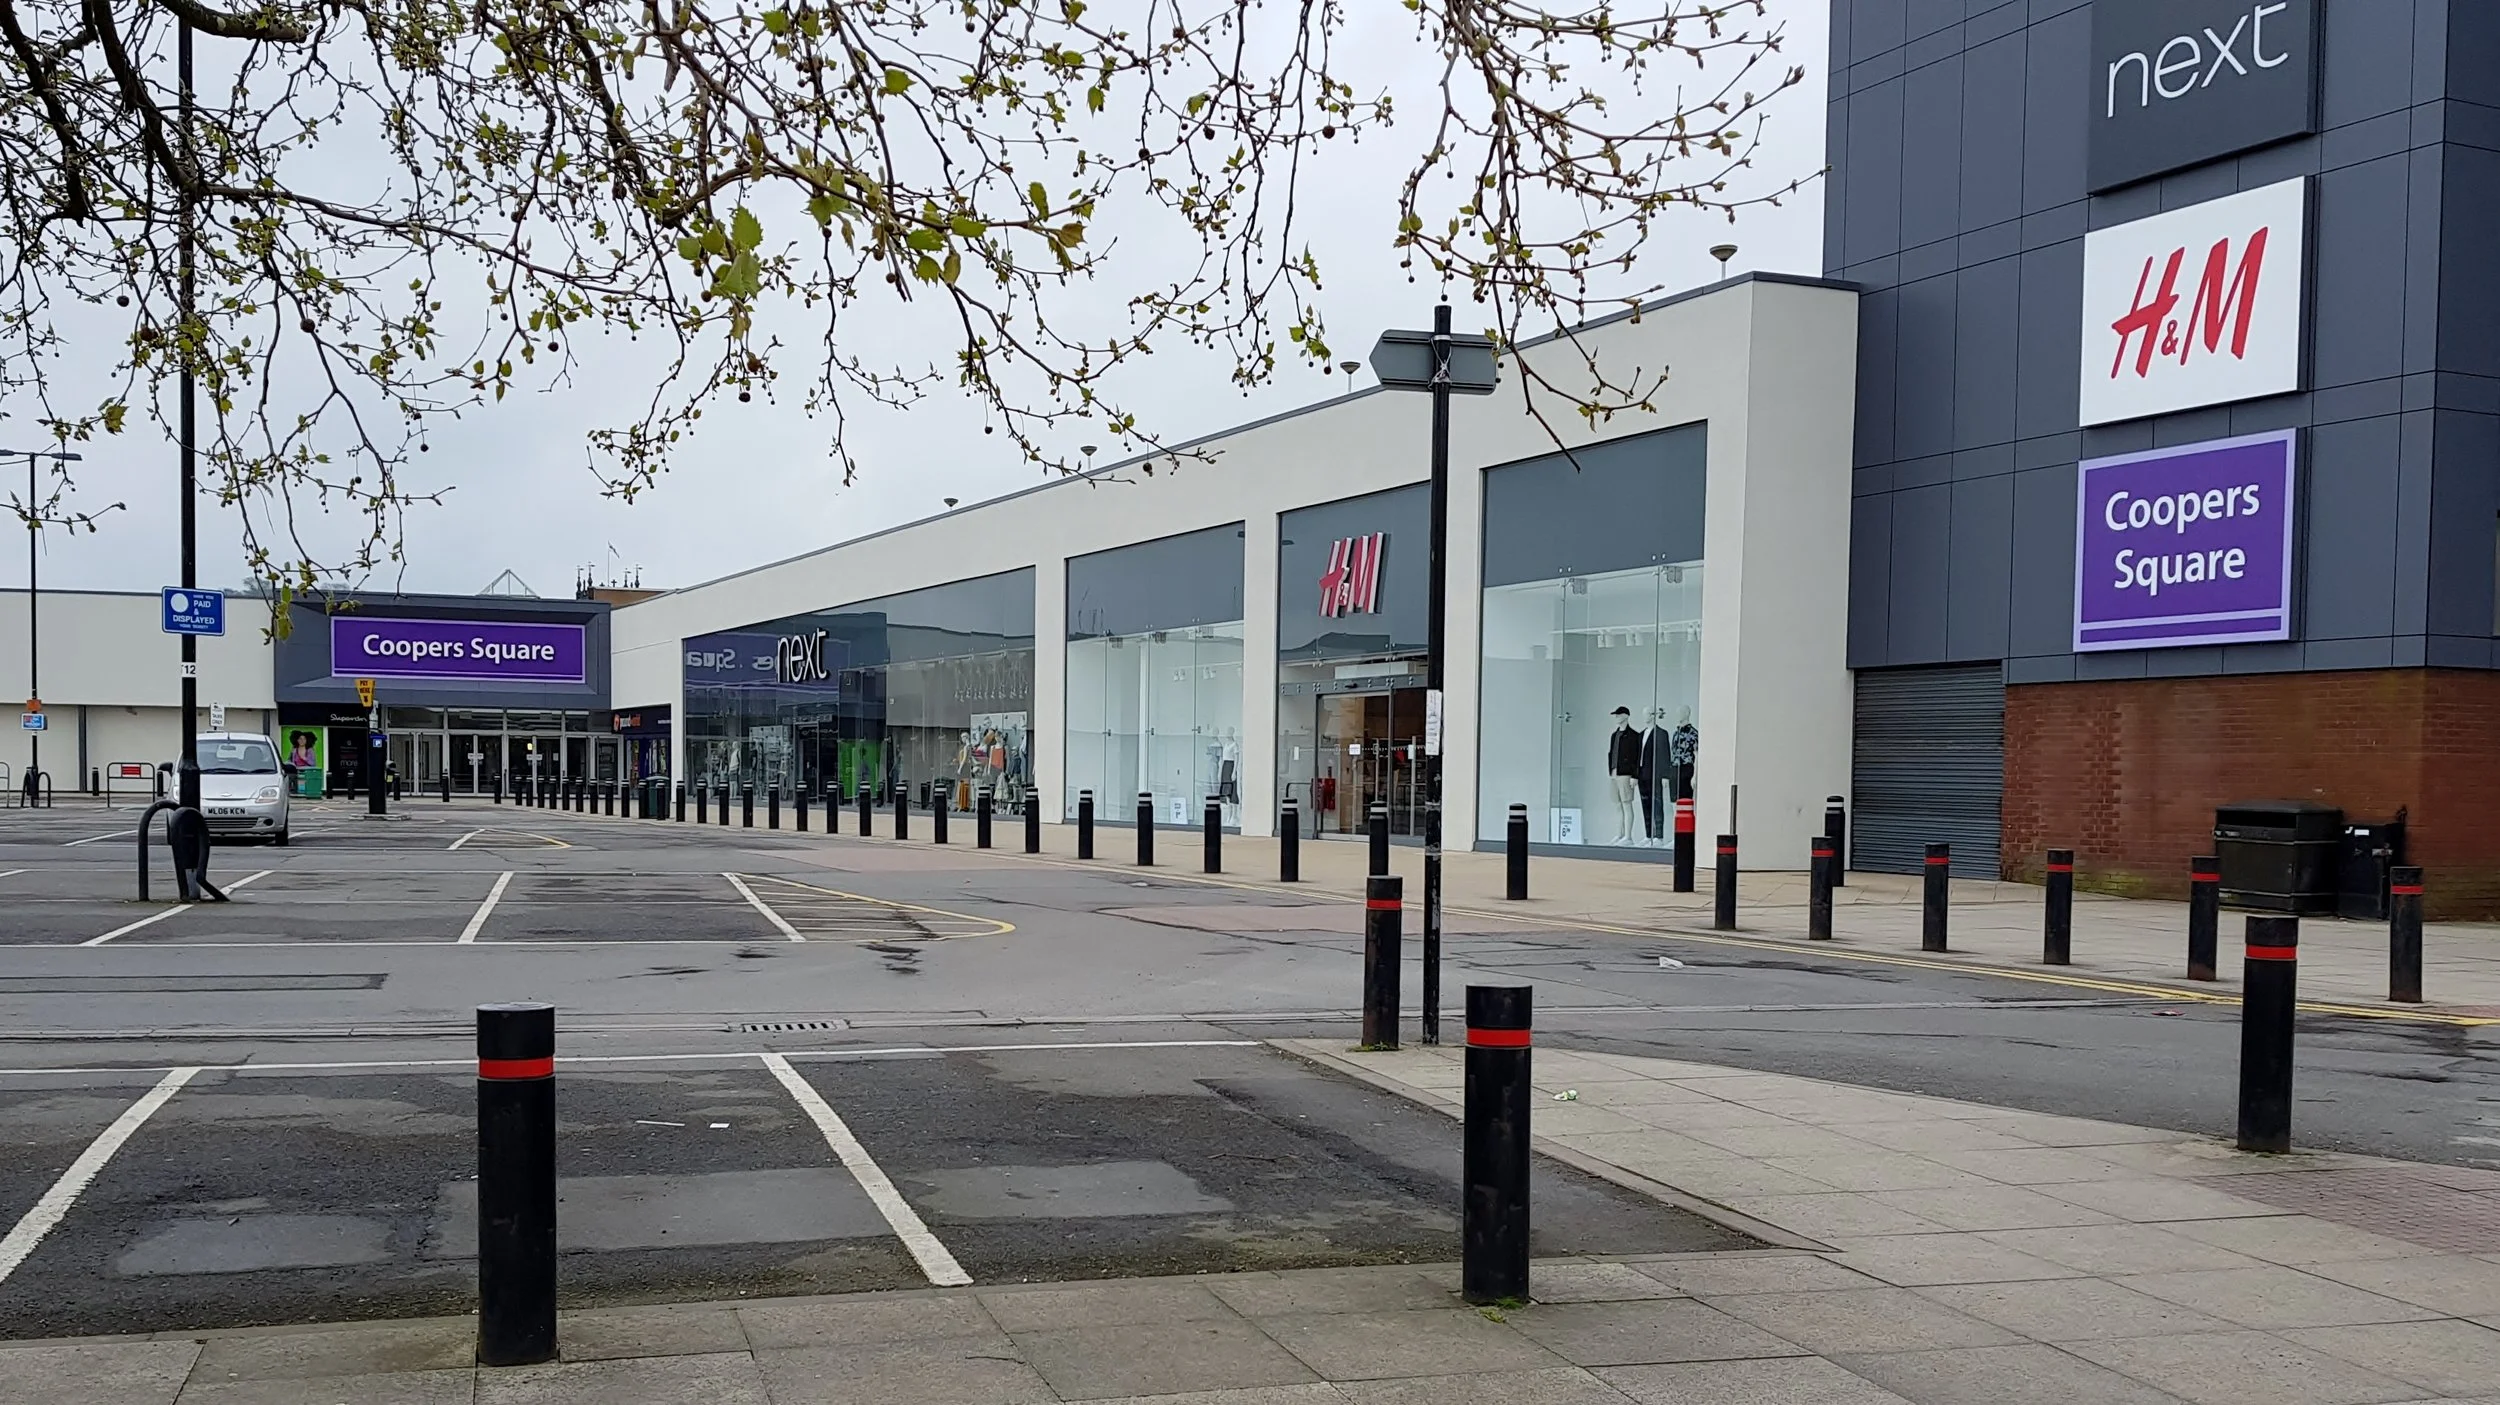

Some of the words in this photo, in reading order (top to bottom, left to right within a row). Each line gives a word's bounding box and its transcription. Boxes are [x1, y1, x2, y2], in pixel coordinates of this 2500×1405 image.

[2107, 2, 2288, 118] next
[2111, 226, 2268, 379] H&M
[2105, 483, 2260, 534] Coopers
[1319, 532, 1383, 618] H&M
[2114, 547, 2246, 596] Square
[172, 614, 215, 624] DISPLAYED
[193, 600, 211, 608] PAID
[182, 664, 196, 675] 12
[363, 634, 464, 661] Coopers
[471, 637, 555, 664] Square
[777, 627, 827, 682] next
